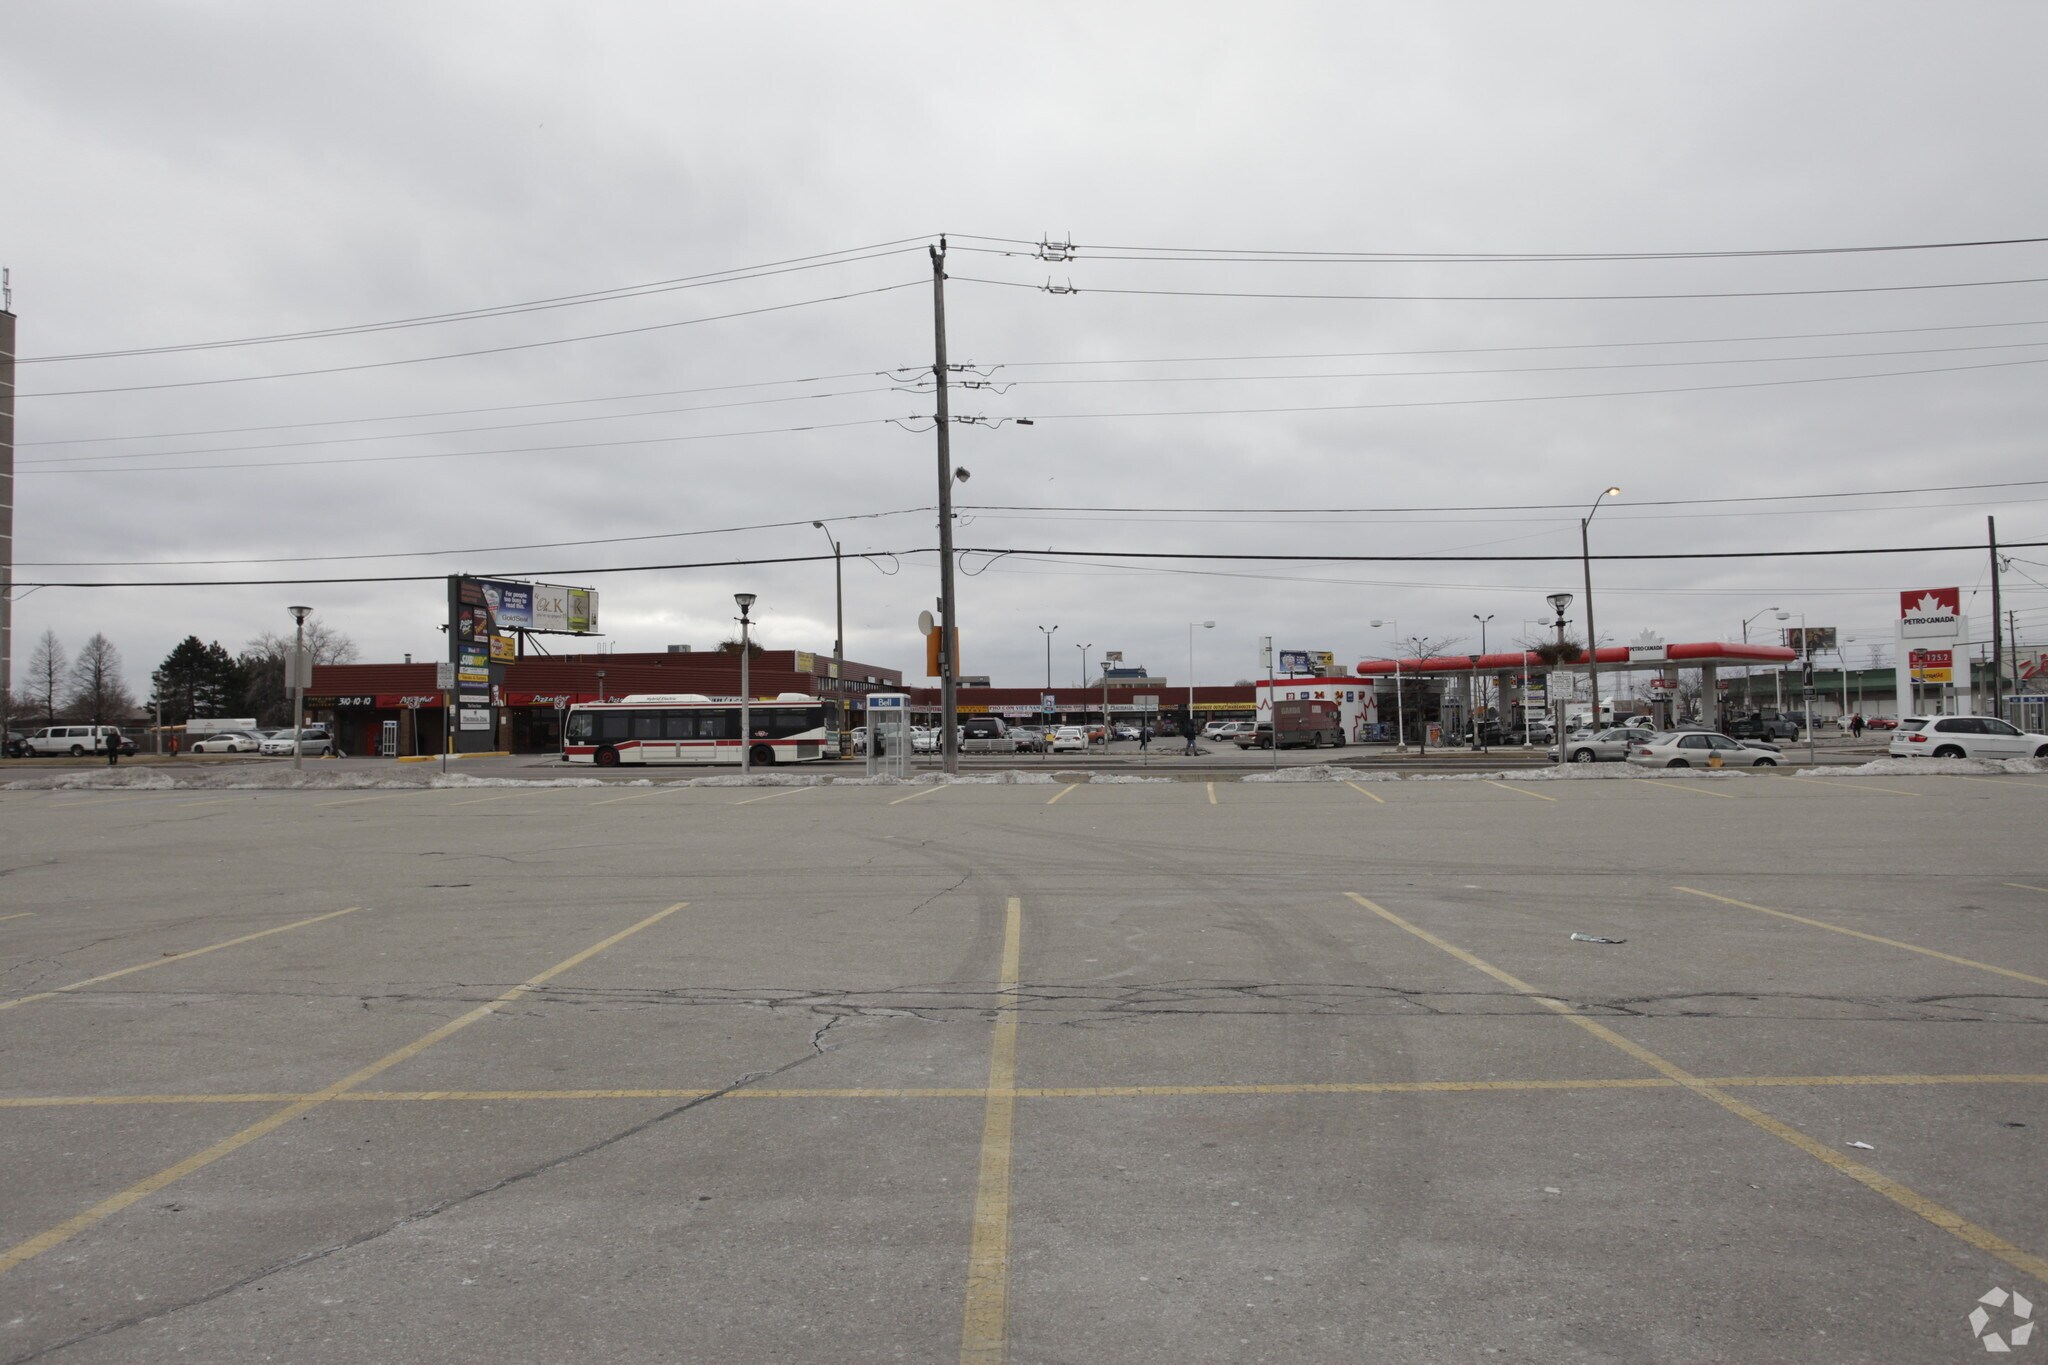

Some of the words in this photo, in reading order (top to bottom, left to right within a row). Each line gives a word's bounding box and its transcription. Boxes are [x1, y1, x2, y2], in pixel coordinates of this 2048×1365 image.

[513, 591, 528, 599] people
[1904, 616, 1955, 625] PETRO-CANADA
[338, 697, 372, 706] 310-10-10
[878, 698, 892, 706] Bell
